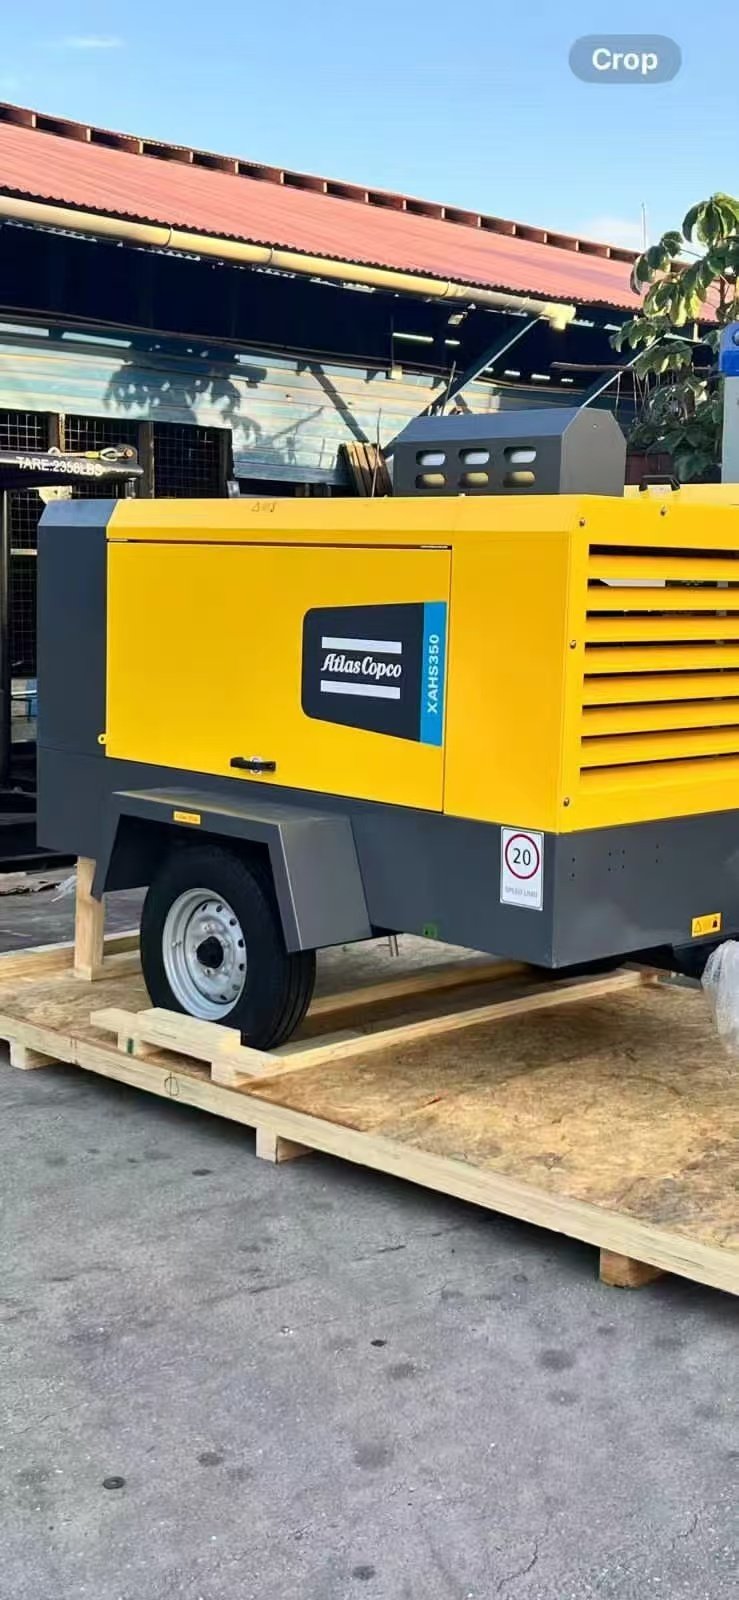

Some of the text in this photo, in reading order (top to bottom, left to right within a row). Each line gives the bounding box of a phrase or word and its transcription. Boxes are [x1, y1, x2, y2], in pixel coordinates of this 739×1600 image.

[320, 653, 402, 680] Atlas Copco
[426, 634, 440, 715] XAHS350
[513, 847, 531, 866] 20
